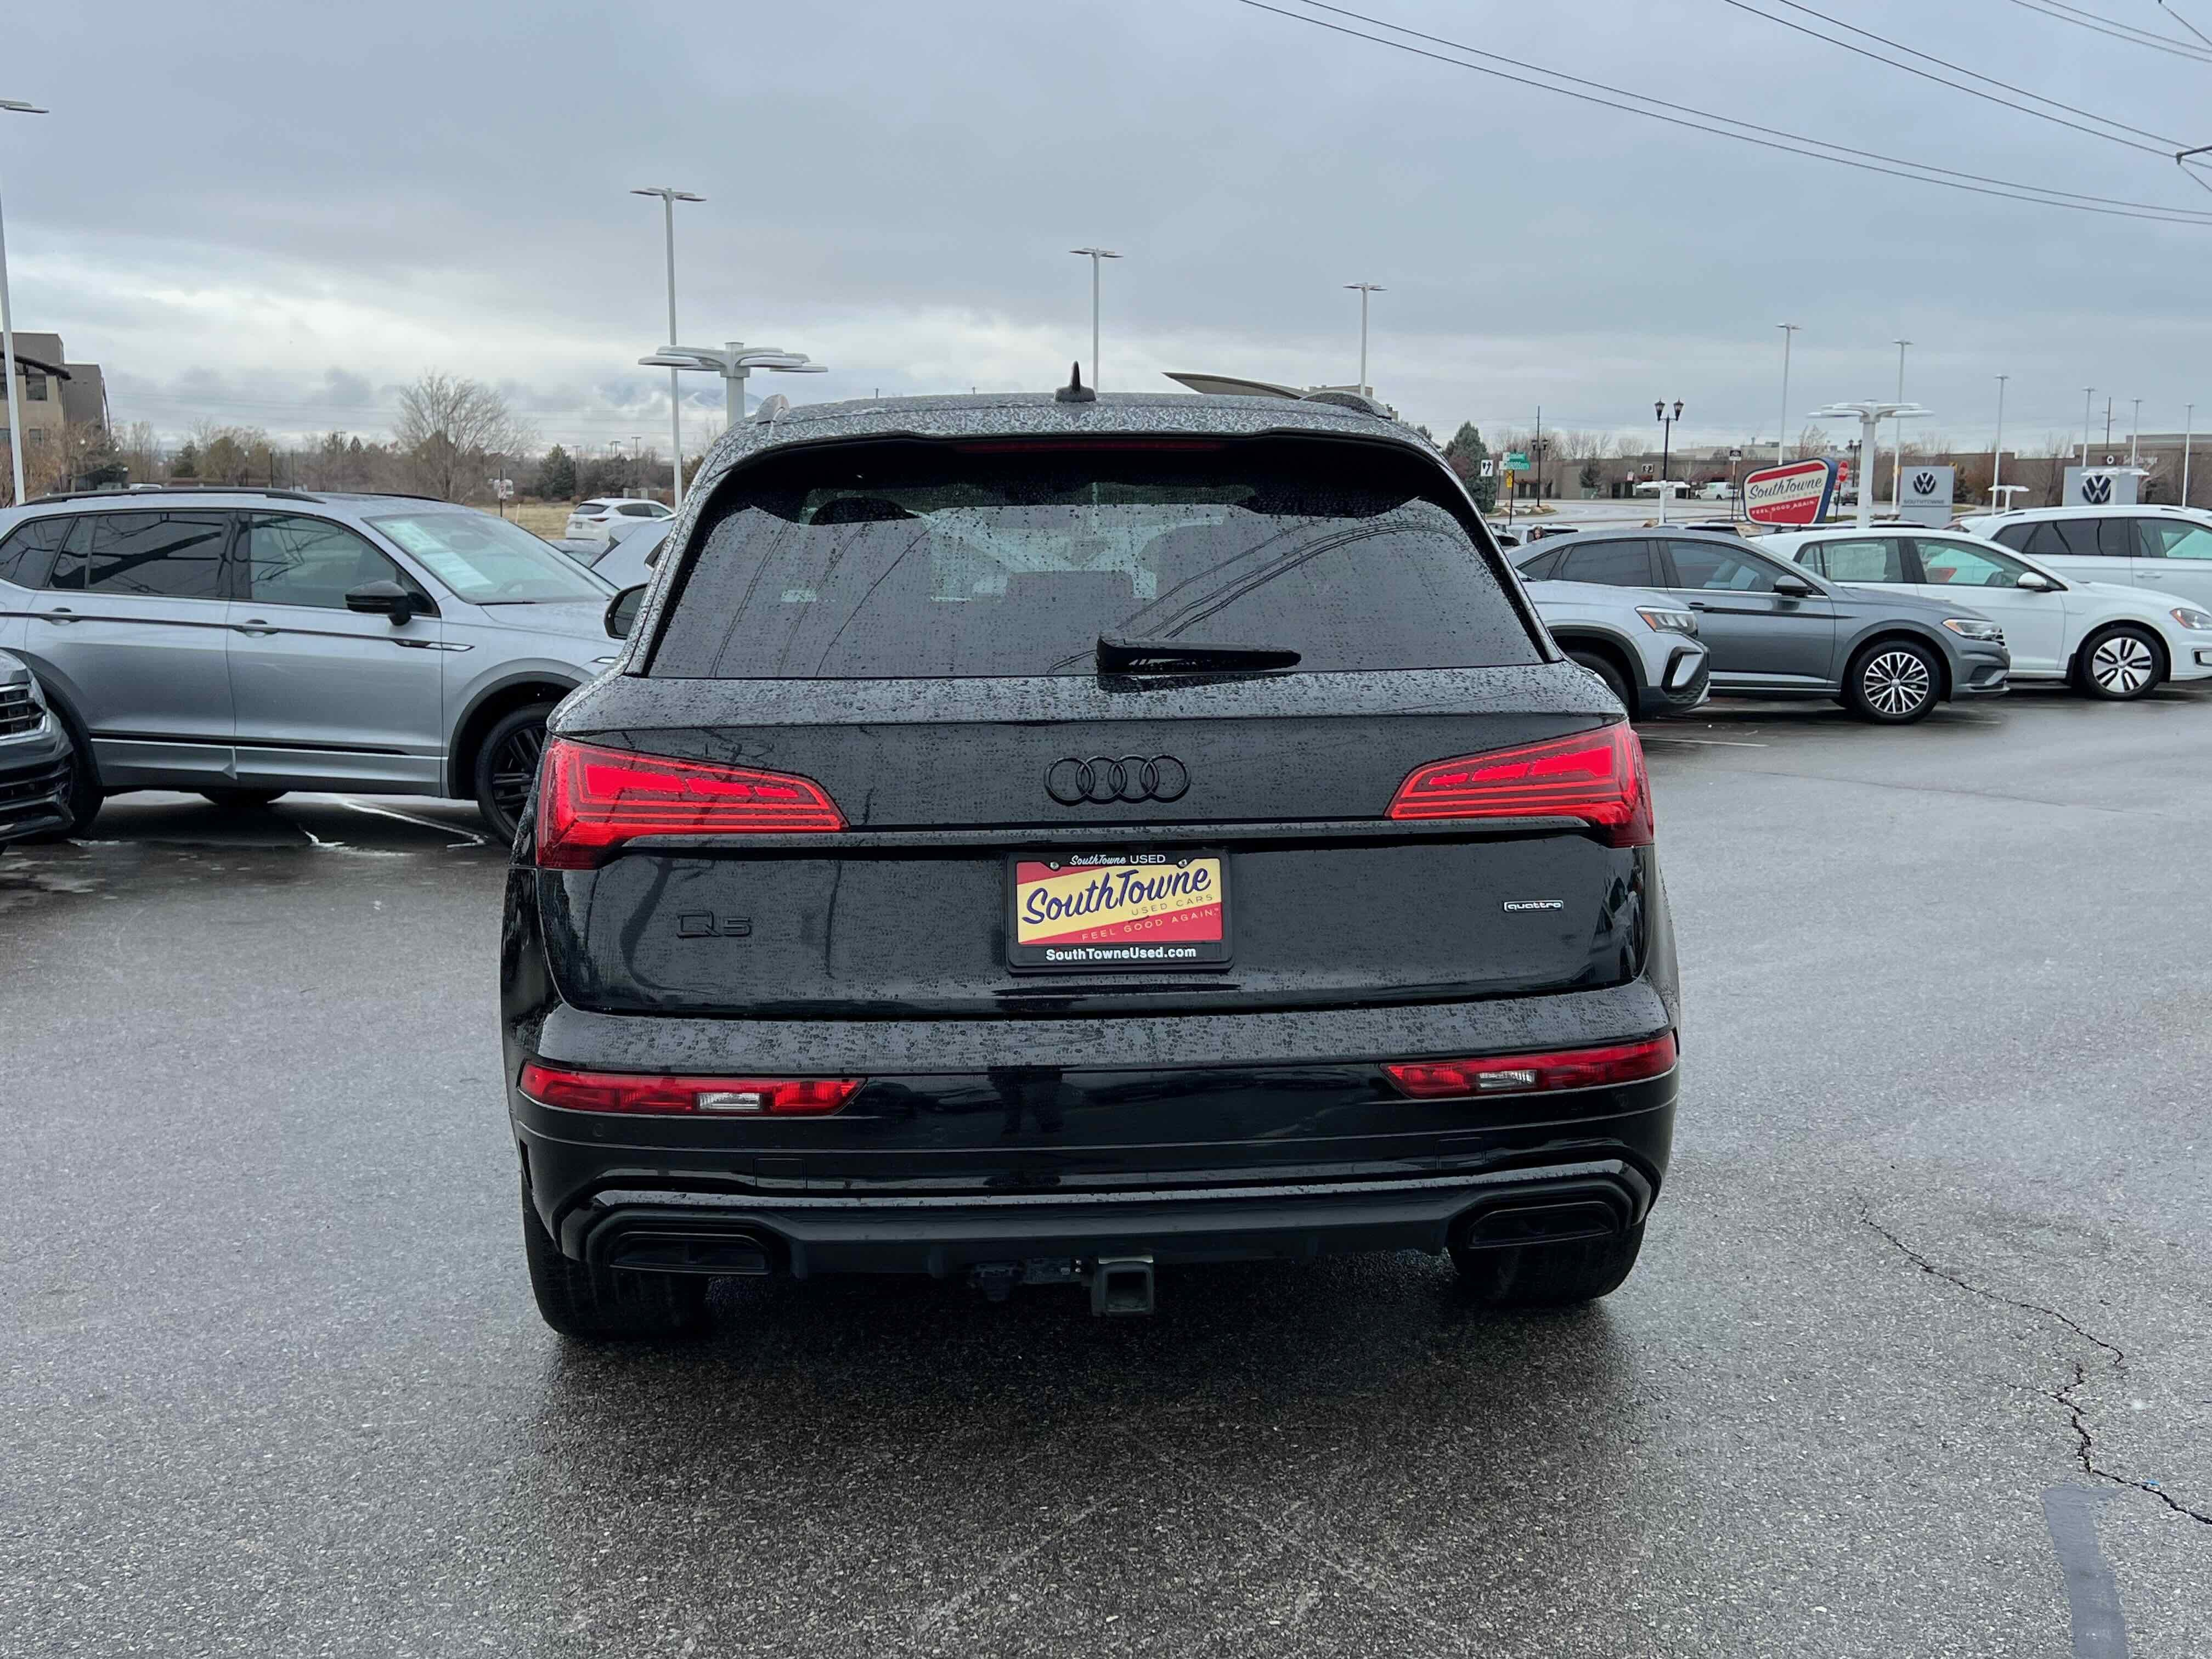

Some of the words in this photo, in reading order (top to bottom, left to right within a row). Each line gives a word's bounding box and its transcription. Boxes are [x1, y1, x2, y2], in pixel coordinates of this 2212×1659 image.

[1748, 477, 1822, 499] SouthTowne
[1070, 855, 1126, 865] SouthTowne
[1130, 855, 1165, 864] USED
[1022, 868, 1211, 924] SouthTowne
[1131, 903, 1167, 916] USED
[1176, 894, 1213, 907] CARS
[676, 910, 753, 939] Q5
[1082, 929, 1115, 941] FEEL
[1124, 919, 1163, 933] GOOD
[1046, 946, 1197, 961] SouthTowneUsed.com
